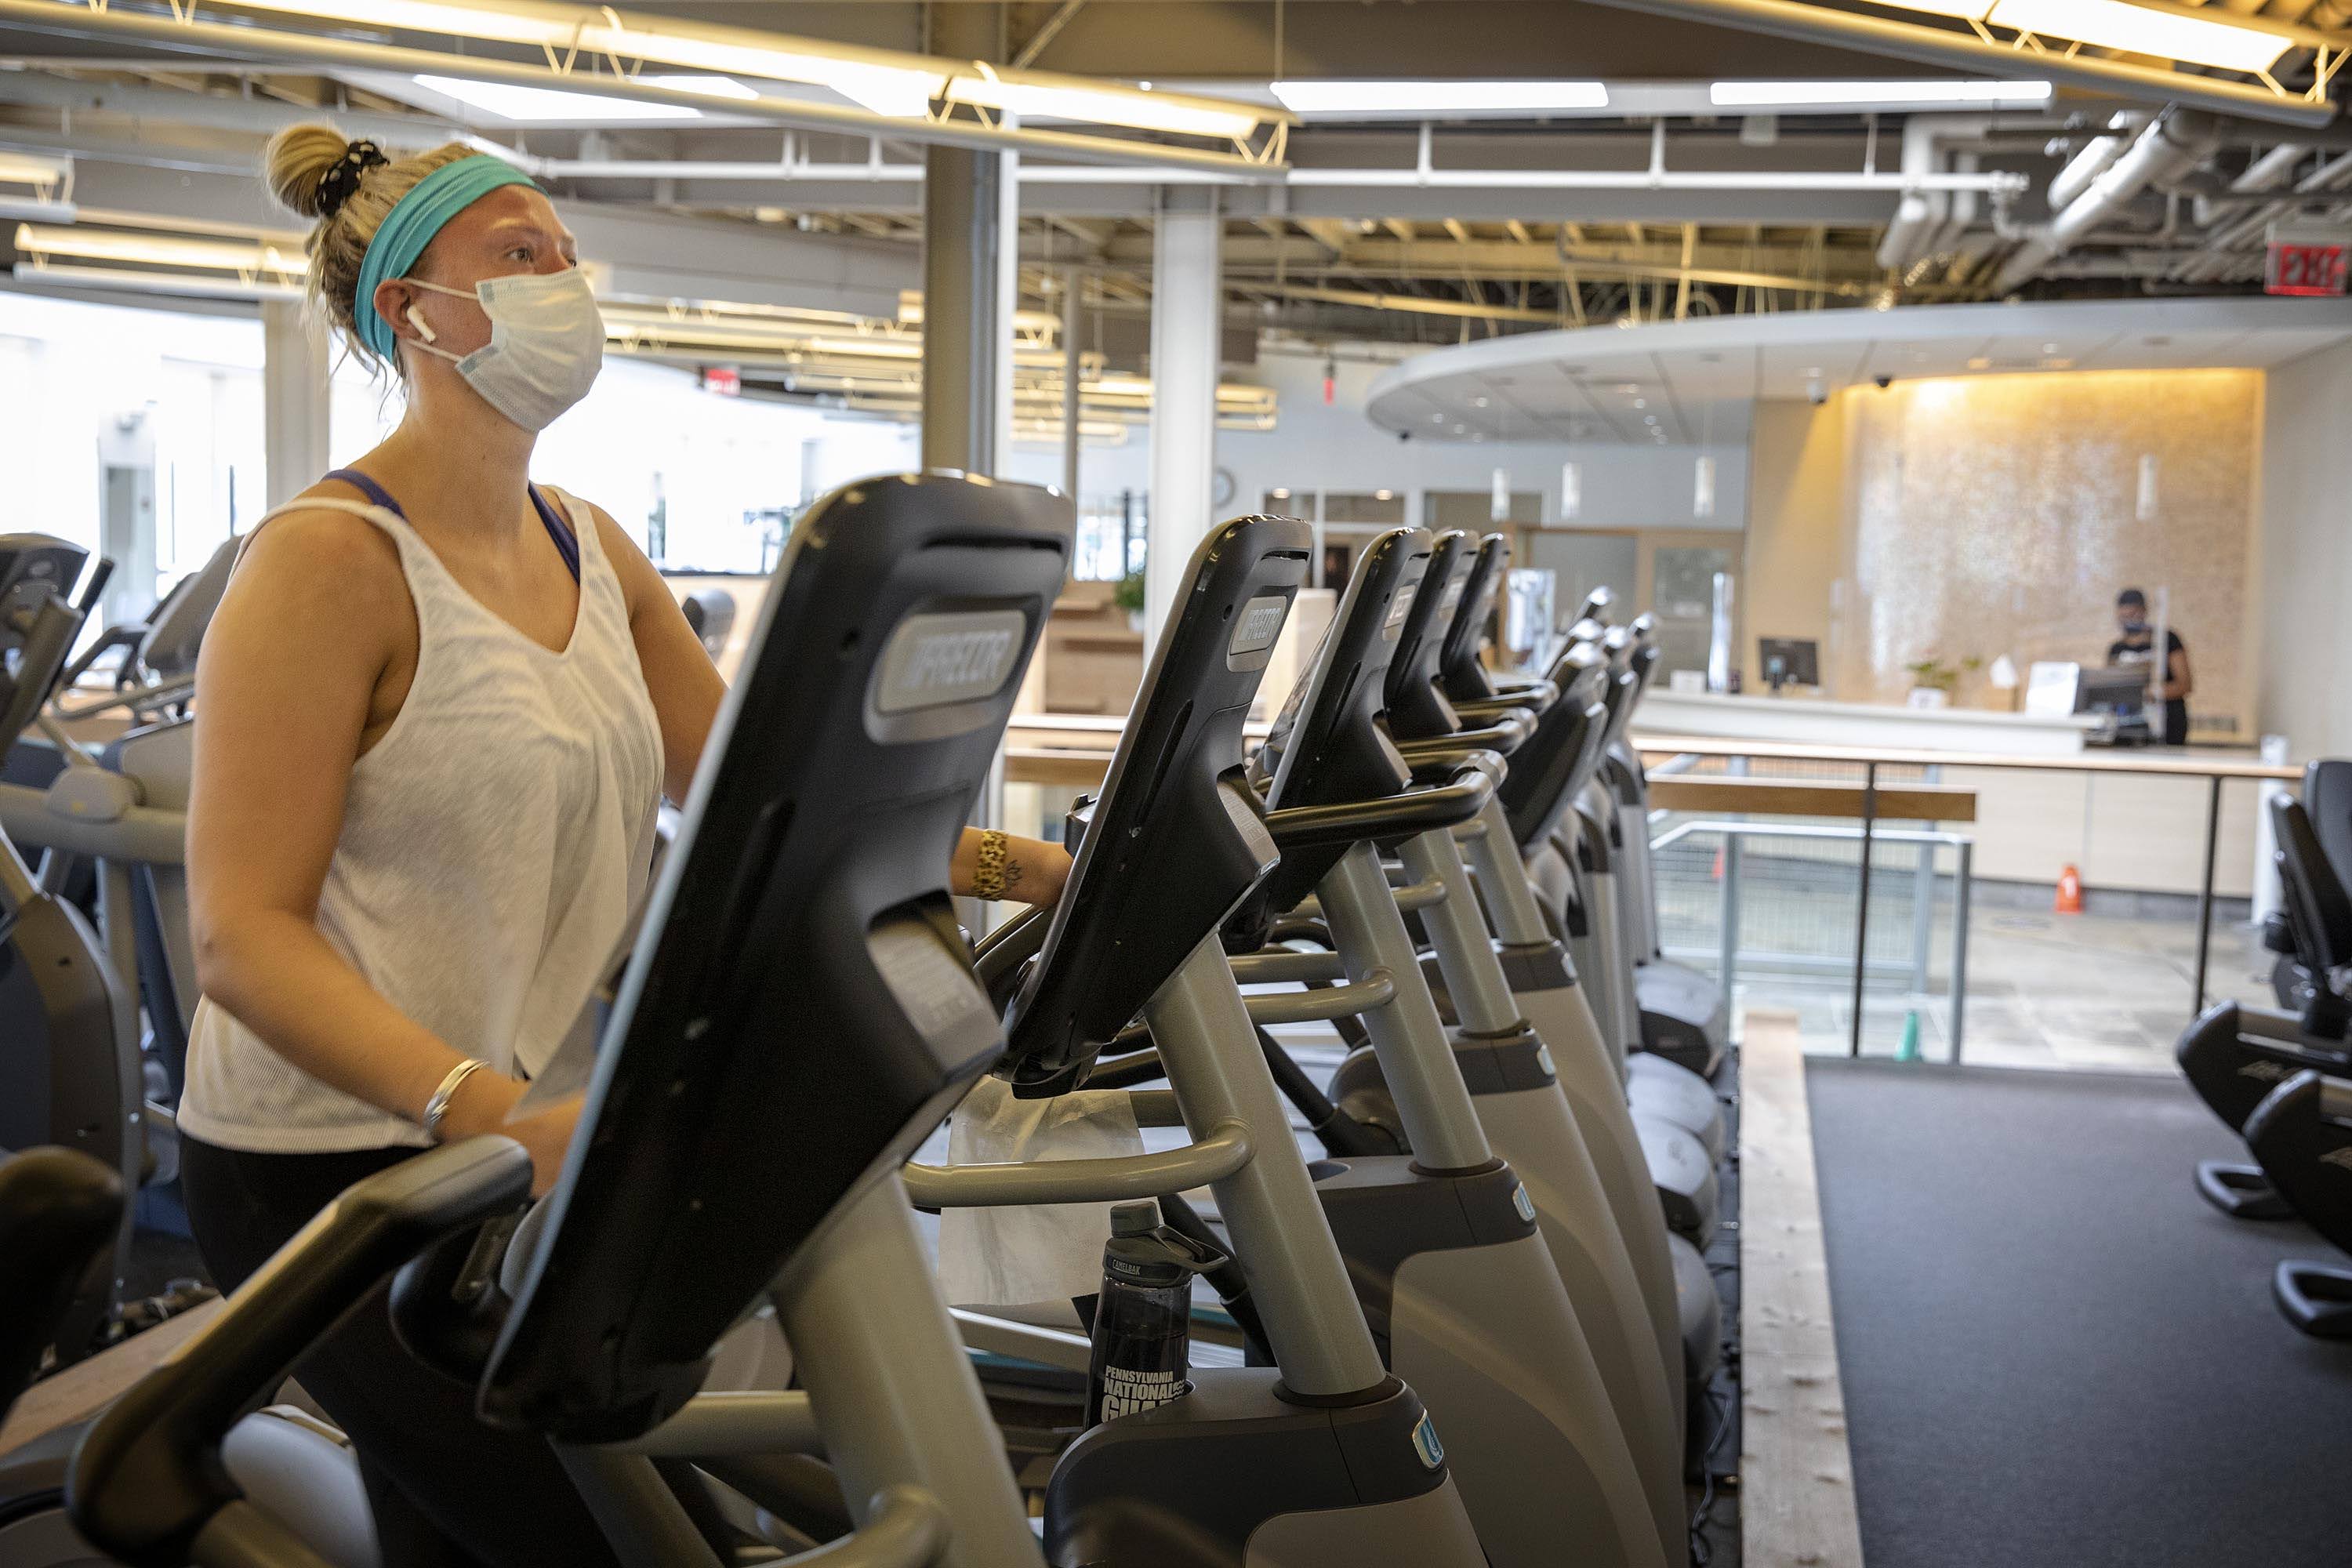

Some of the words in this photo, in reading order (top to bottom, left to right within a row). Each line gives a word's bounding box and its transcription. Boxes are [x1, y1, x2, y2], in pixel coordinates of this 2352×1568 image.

[1112, 1259, 1141, 1276] CAMELBAK
[1106, 1365, 1173, 1384] PENNSYLVANIA
[1104, 1377, 1174, 1399] NATIONAL
